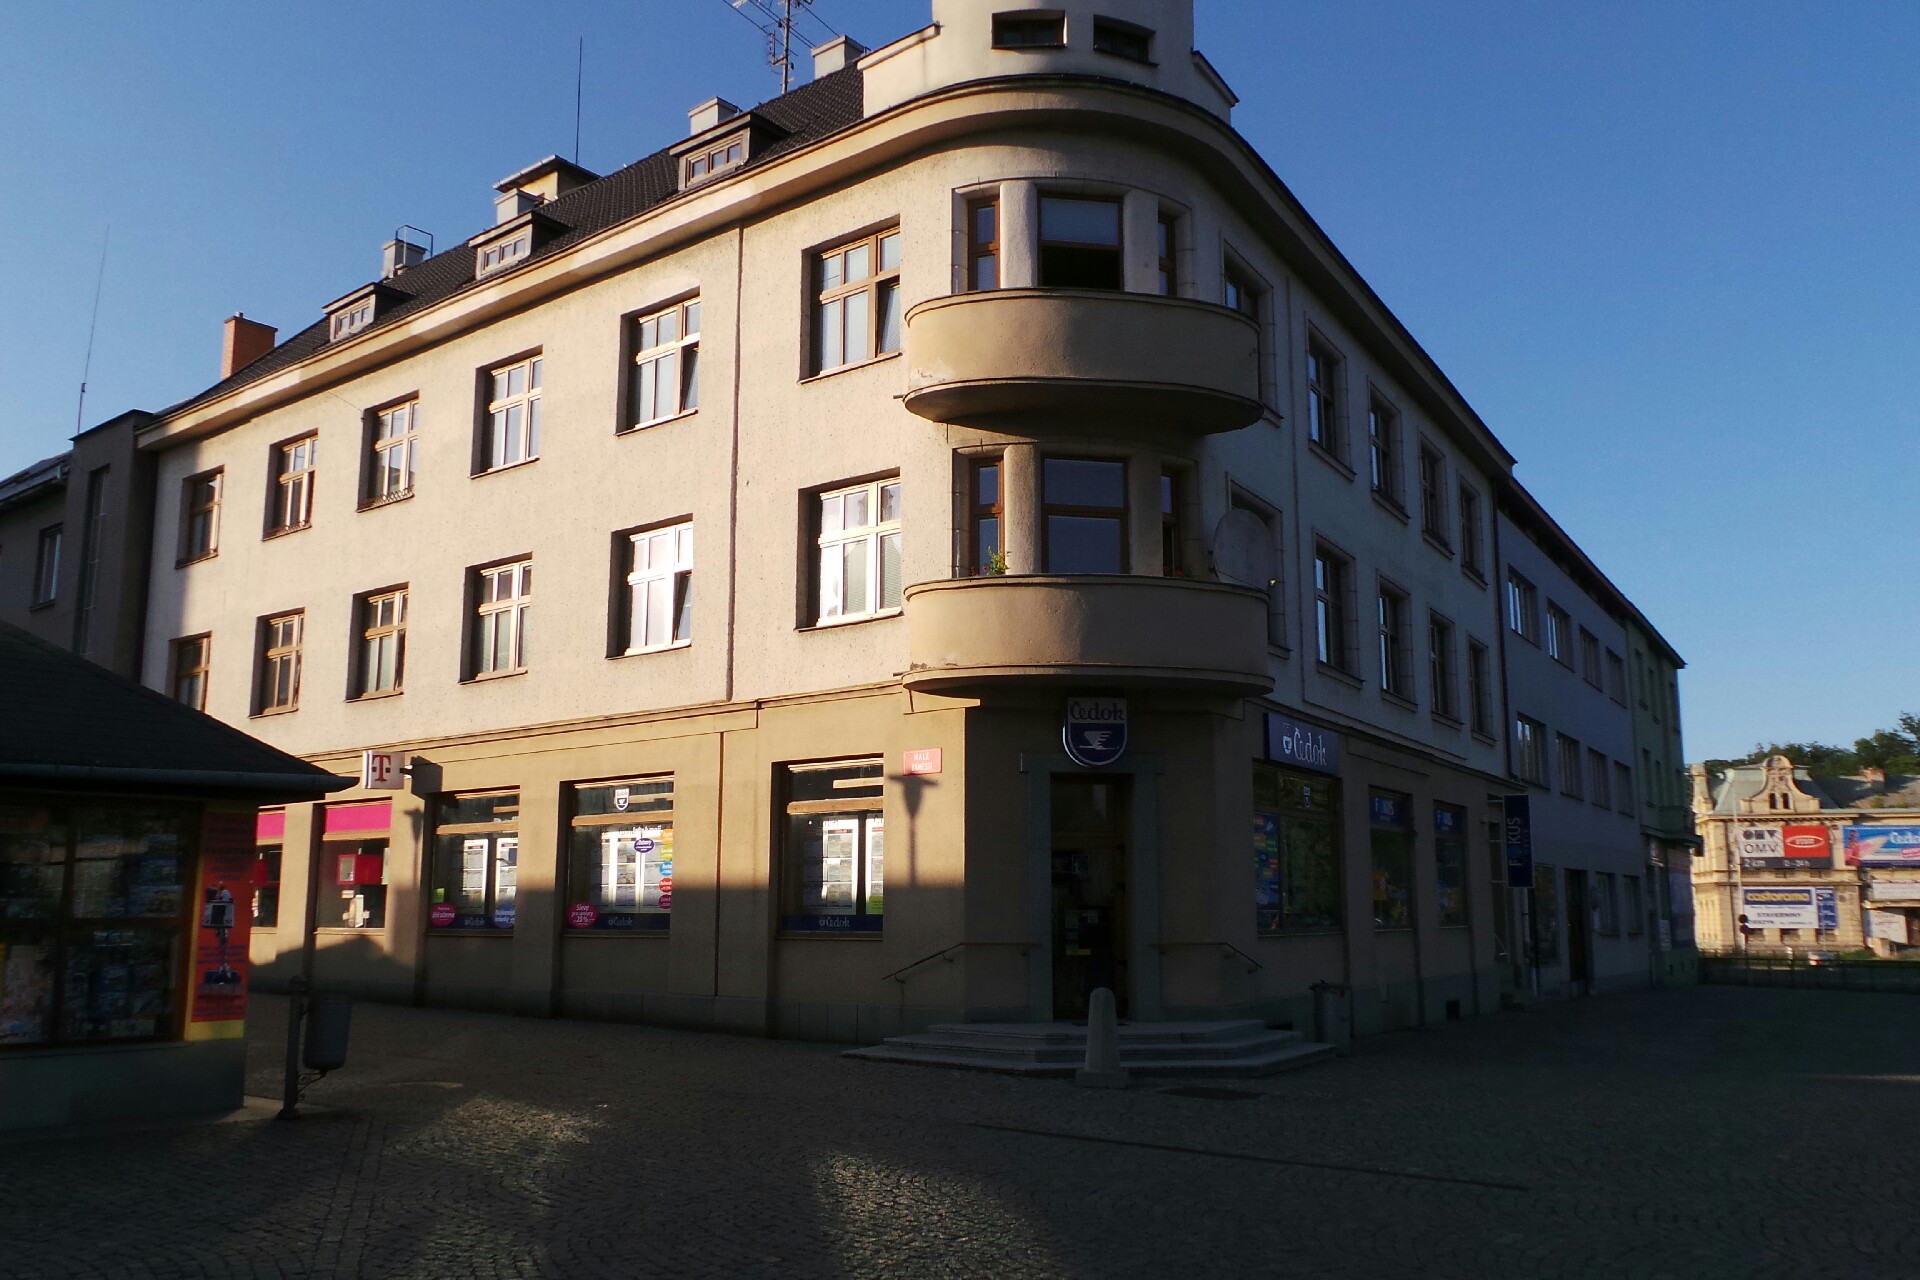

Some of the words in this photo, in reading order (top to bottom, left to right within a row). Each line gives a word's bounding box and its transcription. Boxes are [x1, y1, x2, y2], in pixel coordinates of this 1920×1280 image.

[1070, 700, 1124, 721] Čedok
[1293, 727, 1327, 766] Čedok
[372, 755, 391, 782] T
[1744, 843, 1777, 854] OMV
[826, 916, 850, 928] Čedok
